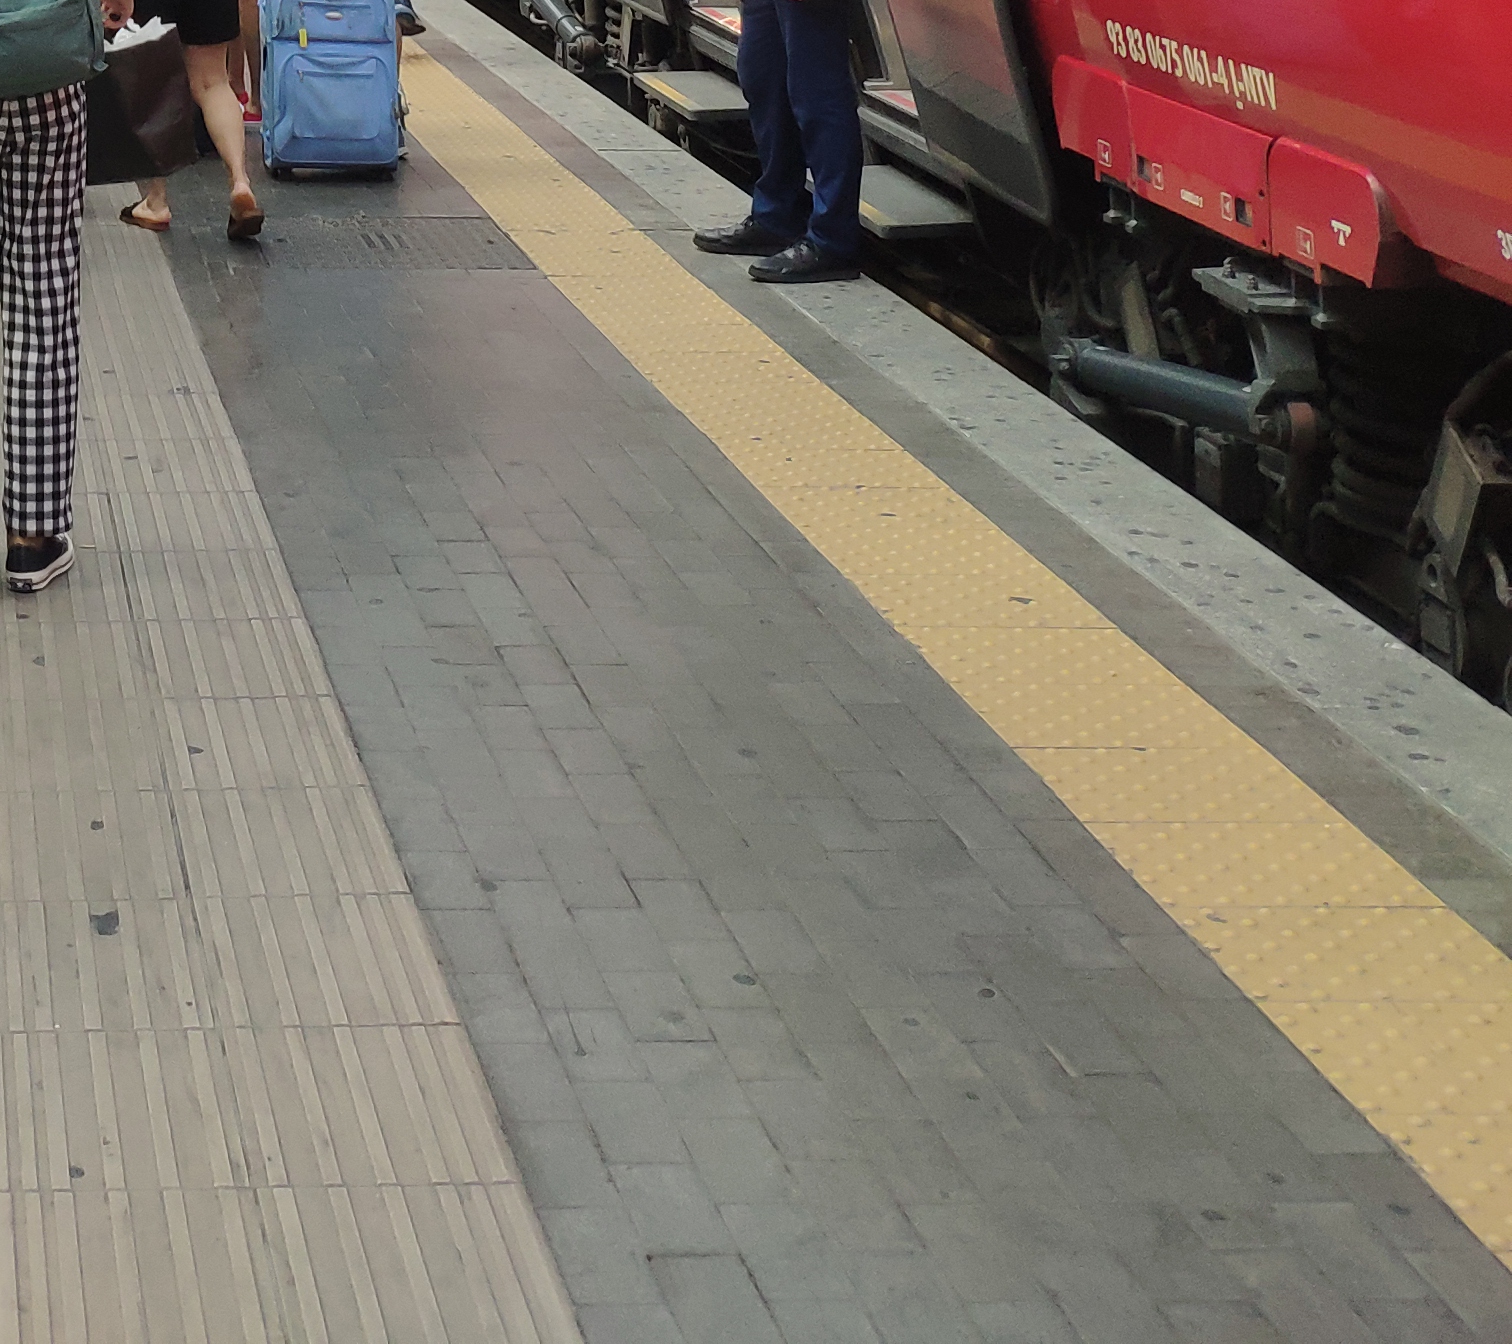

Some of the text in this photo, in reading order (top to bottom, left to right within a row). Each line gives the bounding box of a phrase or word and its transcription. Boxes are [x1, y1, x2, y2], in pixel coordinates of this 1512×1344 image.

[1106, 19, 1127, 59] 93
[1125, 25, 1146, 65] 83
[1145, 32, 1183, 78] 0675
[1182, 44, 1230, 95] 061-4
